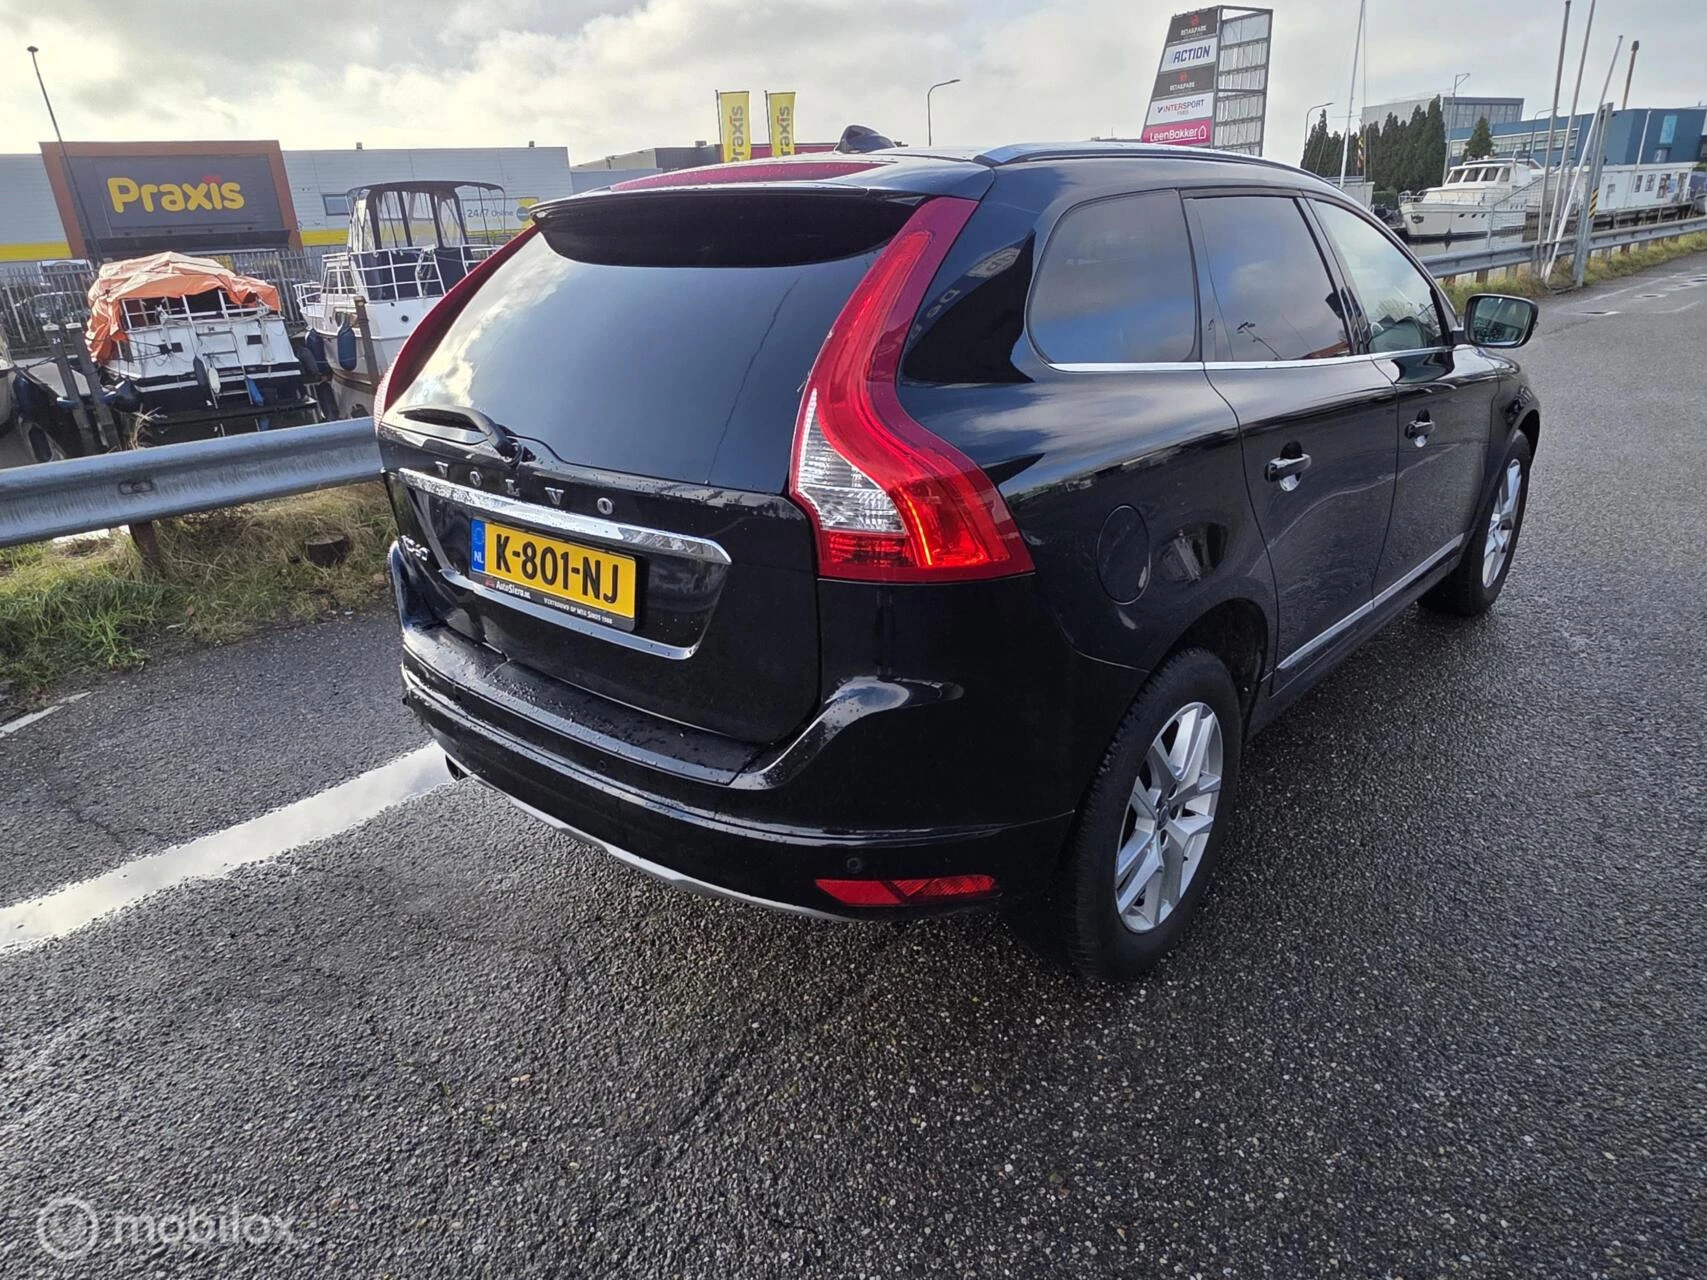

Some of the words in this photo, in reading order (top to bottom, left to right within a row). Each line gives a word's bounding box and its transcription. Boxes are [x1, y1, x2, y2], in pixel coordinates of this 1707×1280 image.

[1173, 45, 1211, 64] ACTION
[1162, 99, 1205, 113] INTERSPORT
[776, 106, 791, 155] raxis
[1150, 127, 1199, 142] LeenBakker
[107, 176, 245, 213] Praxis
[435, 460, 615, 516] VOLVO
[473, 550, 485, 564] NL
[495, 533, 619, 604] K-801-NJ
